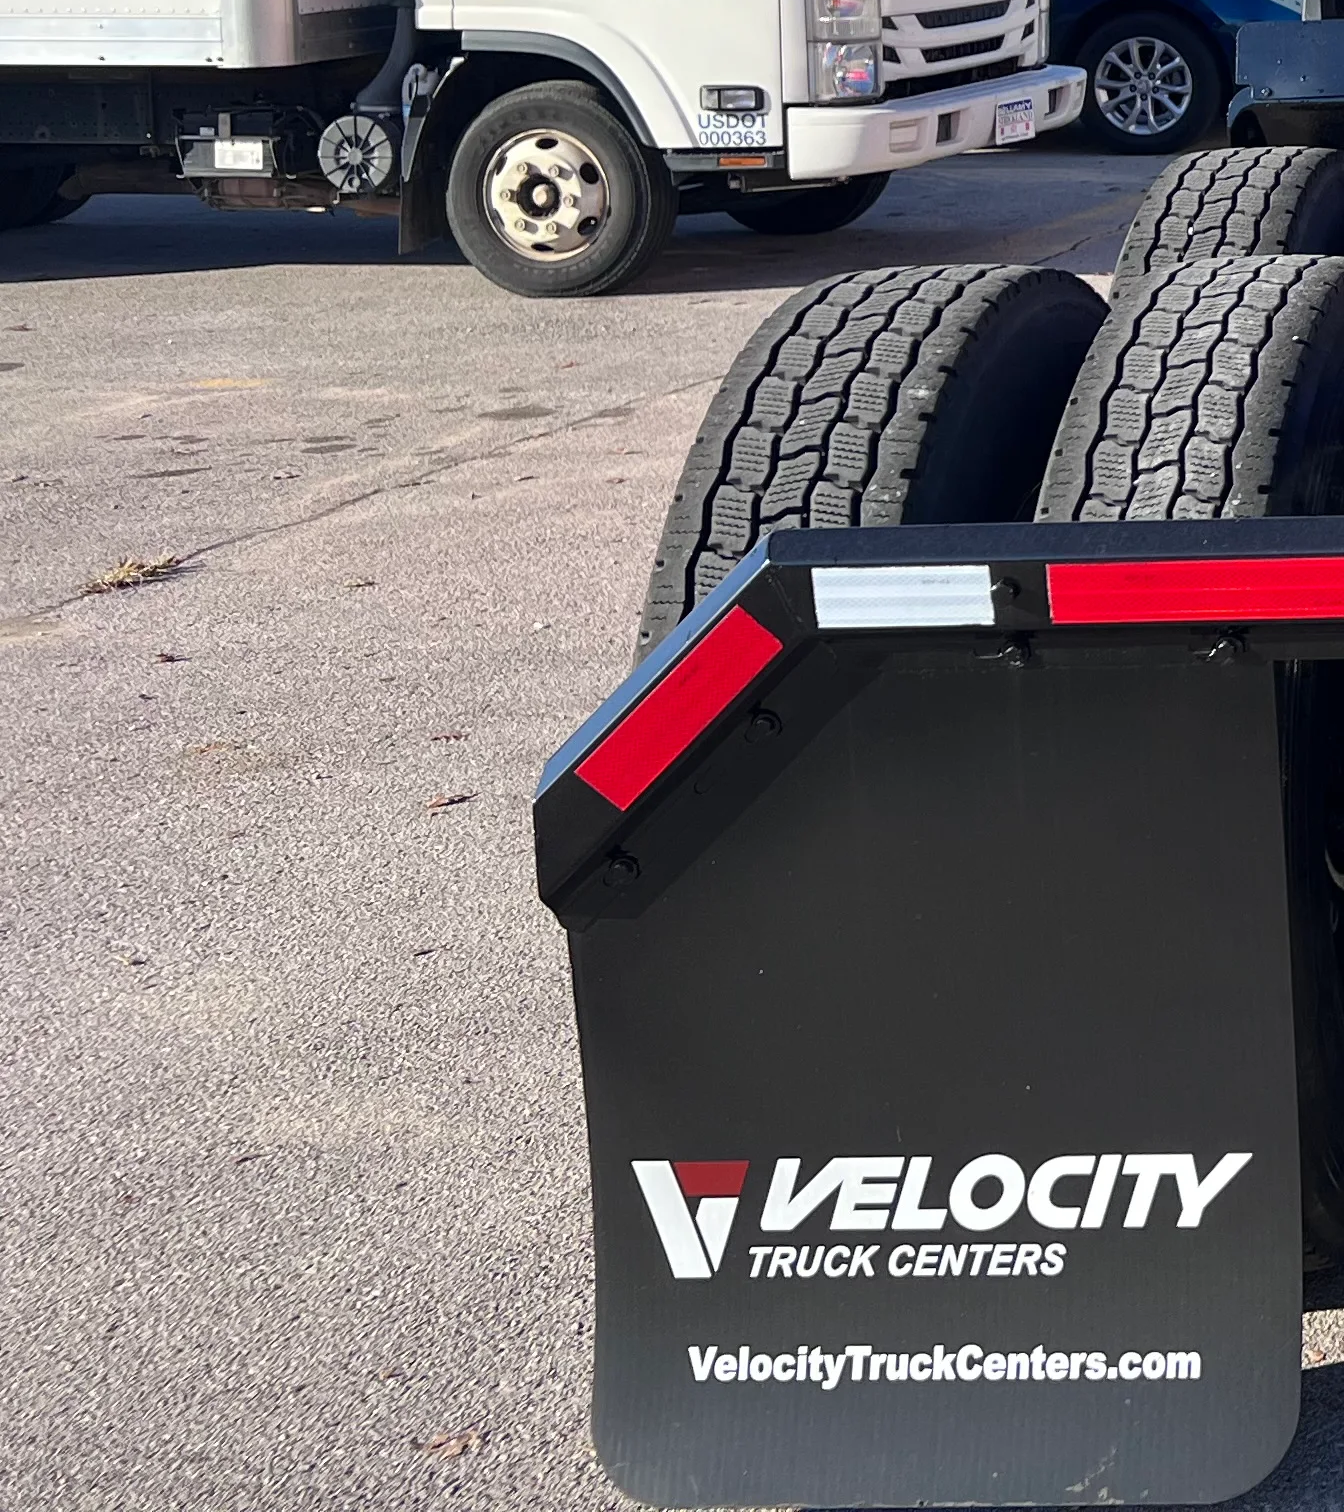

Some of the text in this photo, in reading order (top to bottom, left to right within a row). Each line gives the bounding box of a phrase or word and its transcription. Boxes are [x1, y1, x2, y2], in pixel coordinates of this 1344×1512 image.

[697, 112, 768, 129] USDOT
[699, 130, 767, 146] 000363
[759, 1152, 1254, 1233] VELOCITY
[747, 1242, 1068, 1279] TRUCK CENTERS
[688, 1344, 1202, 1390] VelocityTruckCenters.com
